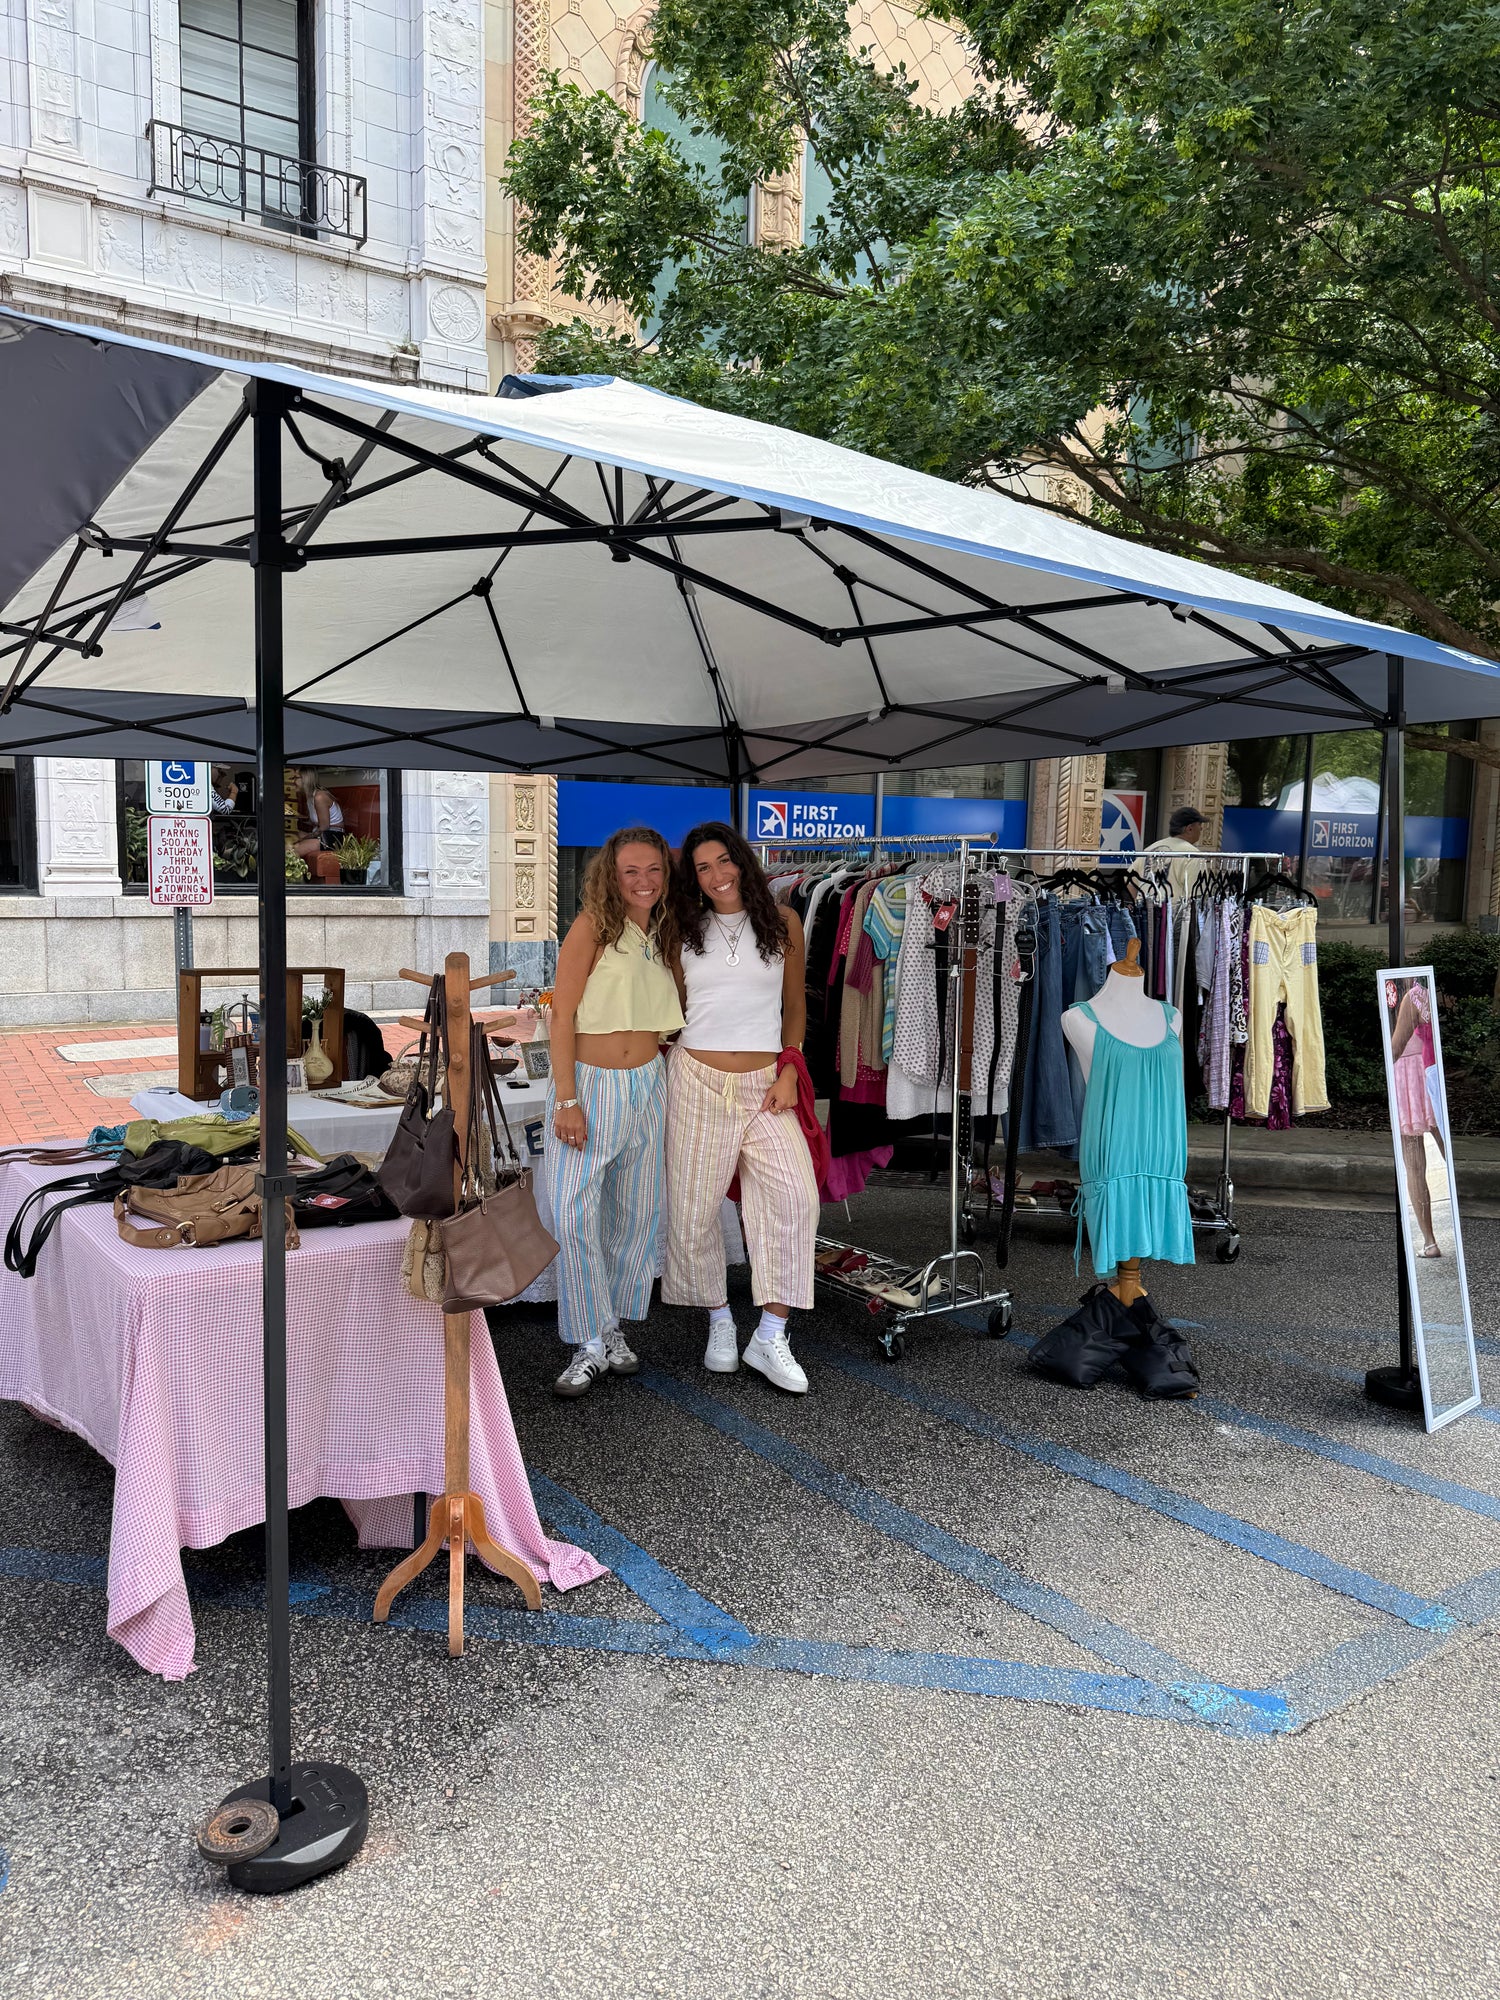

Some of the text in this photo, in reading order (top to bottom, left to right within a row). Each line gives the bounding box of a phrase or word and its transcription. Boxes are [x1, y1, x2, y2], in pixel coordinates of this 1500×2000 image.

[164, 800, 193, 809] FINE
[793, 805, 838, 820] FIRST
[174, 820, 187, 828] NO
[1332, 822, 1359, 834] FIRST
[160, 829, 200, 838] PARKING
[792, 822, 866, 838] HORIZON
[161, 838, 200, 847] 5:00 A.M.
[1331, 836, 1375, 848] HORIZON
[157, 847, 203, 856] SATURDAY
[170, 857, 193, 865] THRU
[162, 866, 200, 874] 2:00 P.M.
[158, 875, 204, 884] SATURDAY
[165, 885, 199, 893] TOWING
[158, 894, 205, 902] ENFORCED
